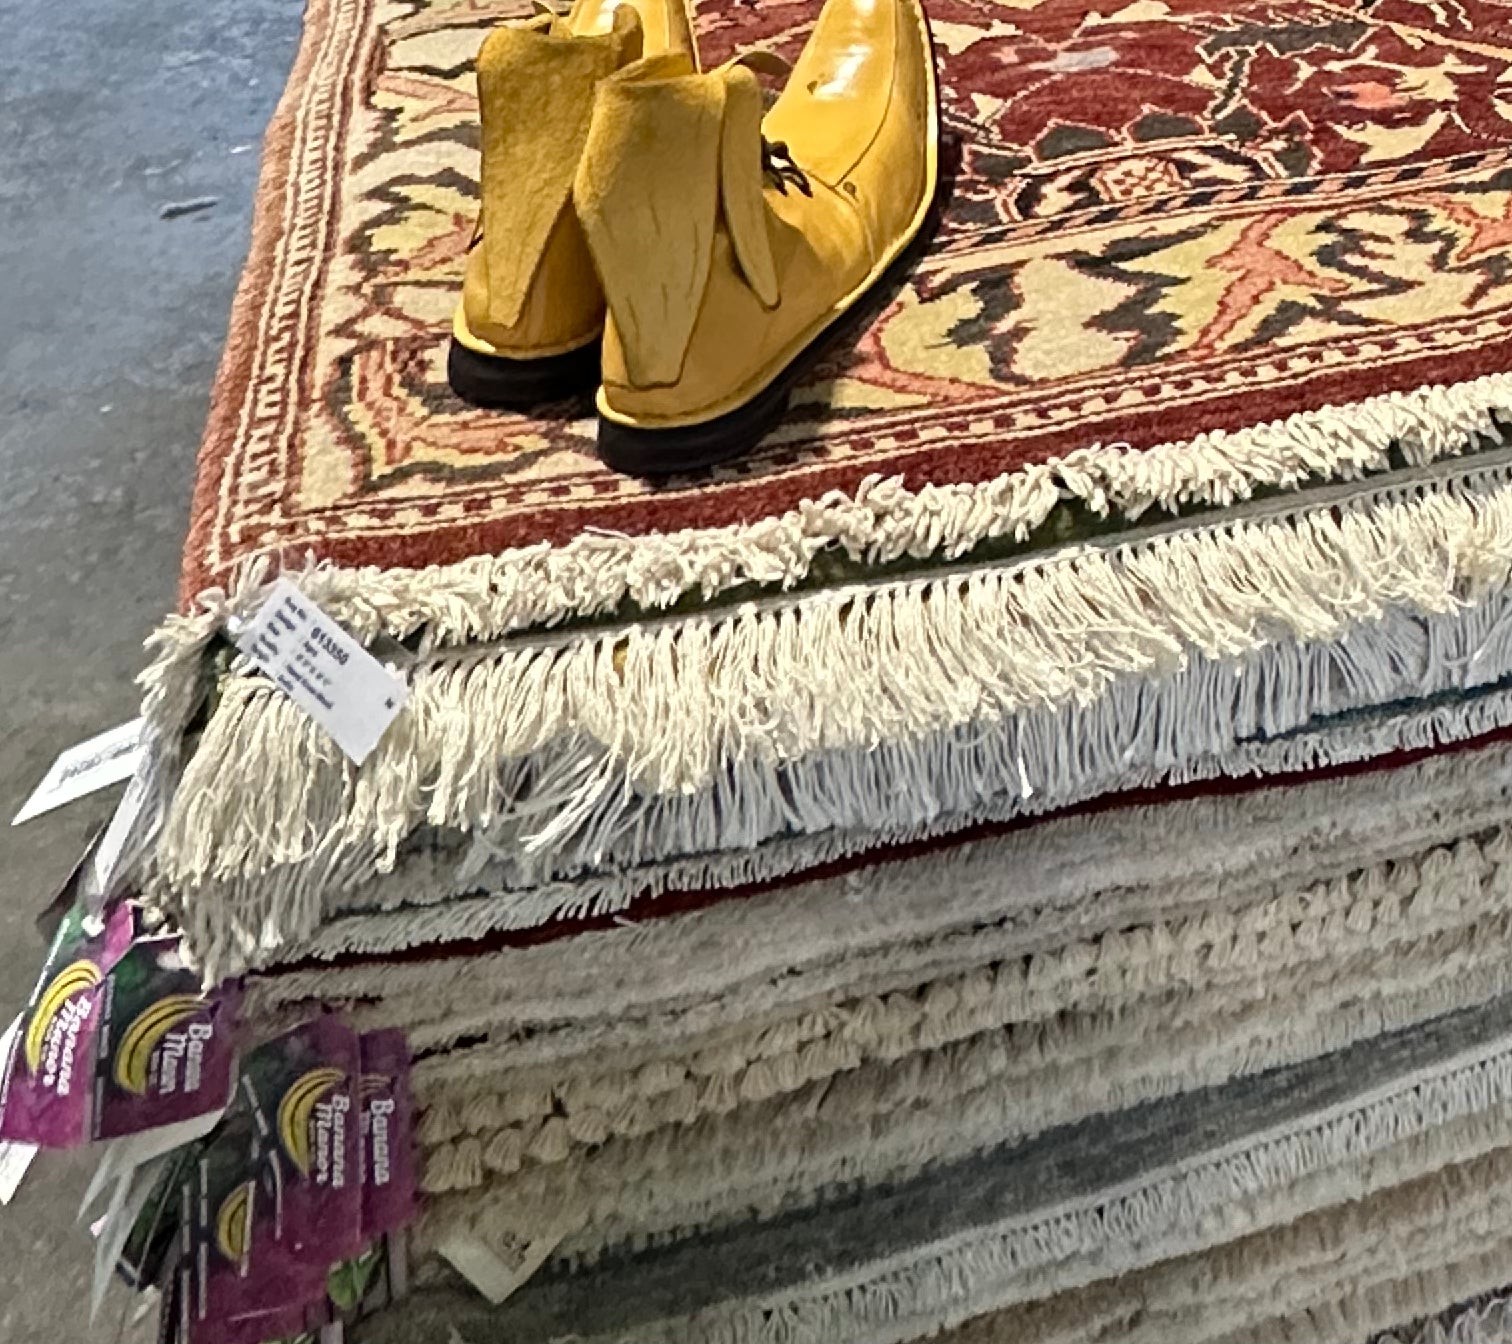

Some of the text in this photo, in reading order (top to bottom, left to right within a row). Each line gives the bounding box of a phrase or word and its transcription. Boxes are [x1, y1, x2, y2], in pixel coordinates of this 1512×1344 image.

[314, 1101, 332, 1184] Manor
[332, 1094, 350, 1188] Banana
[371, 1098, 395, 1186] Banana
